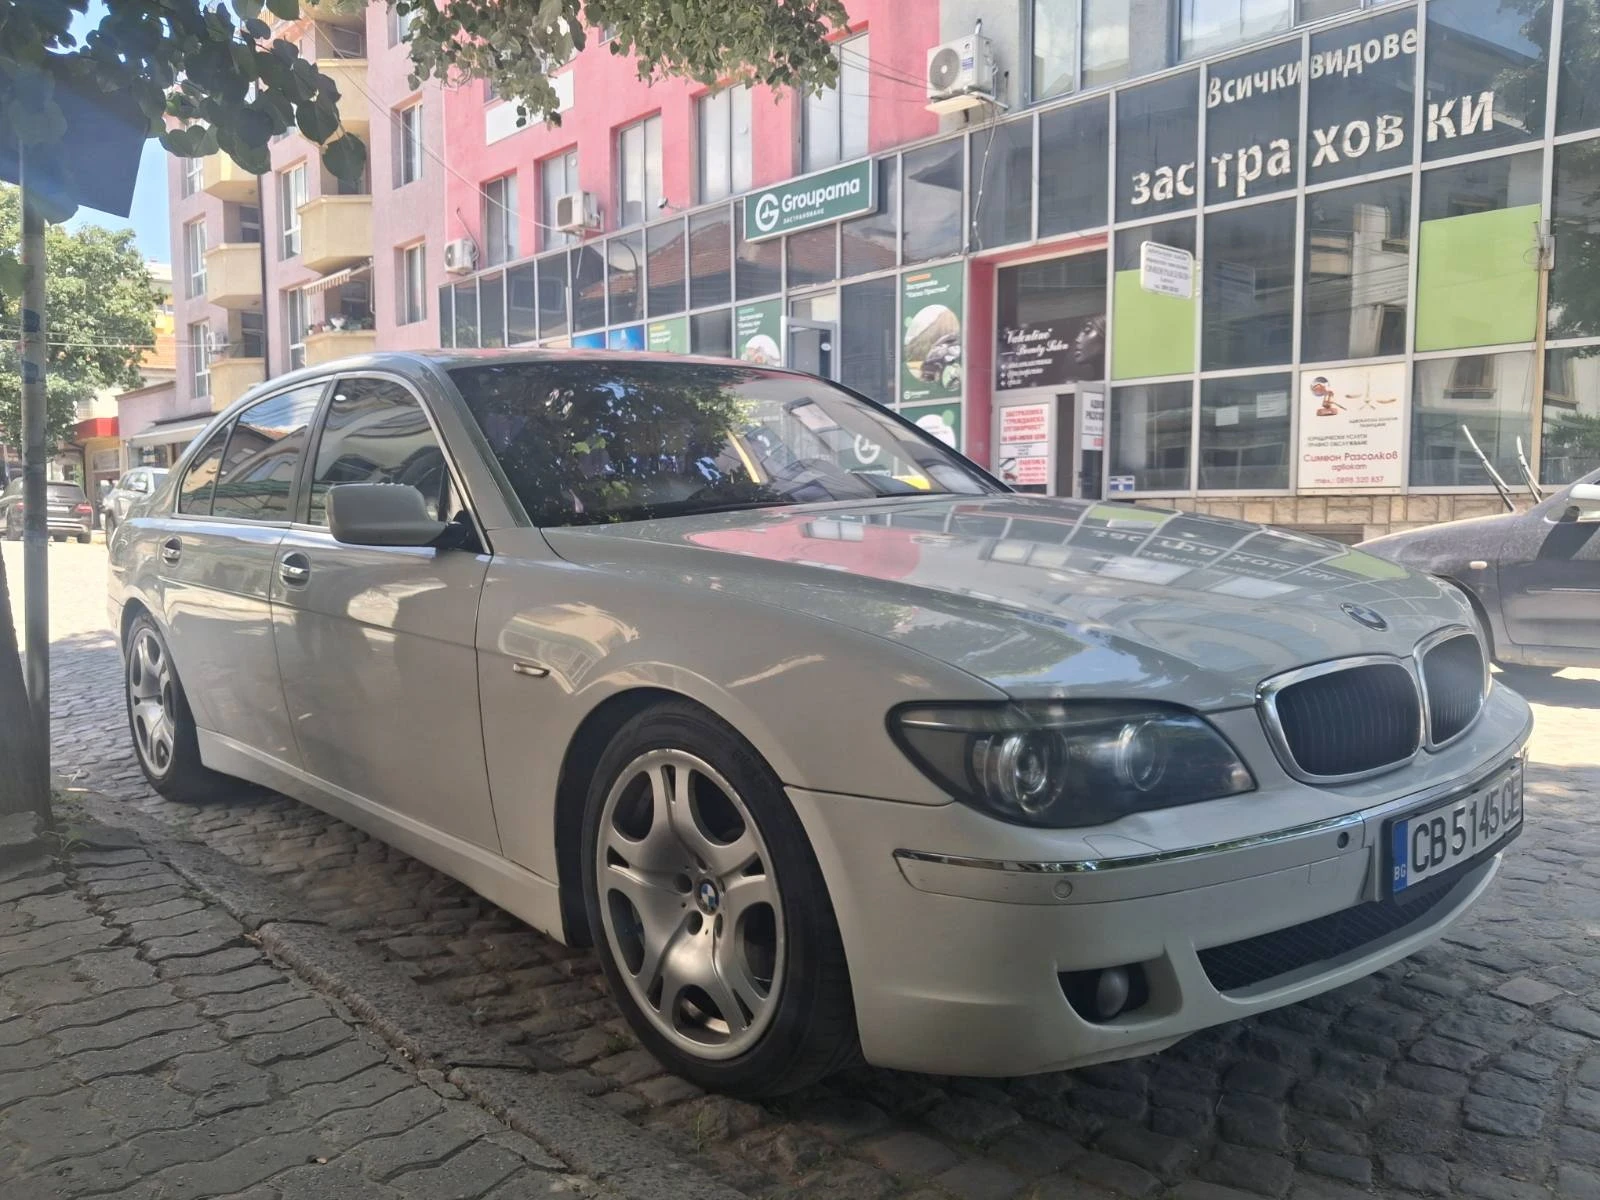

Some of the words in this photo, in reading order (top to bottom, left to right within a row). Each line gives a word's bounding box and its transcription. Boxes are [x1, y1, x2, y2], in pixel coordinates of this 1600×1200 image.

[1207, 64, 1302, 109] Всички
[1310, 27, 1417, 80] видове
[782, 178, 860, 213] Groupama
[1393, 864, 1406, 881] BG
